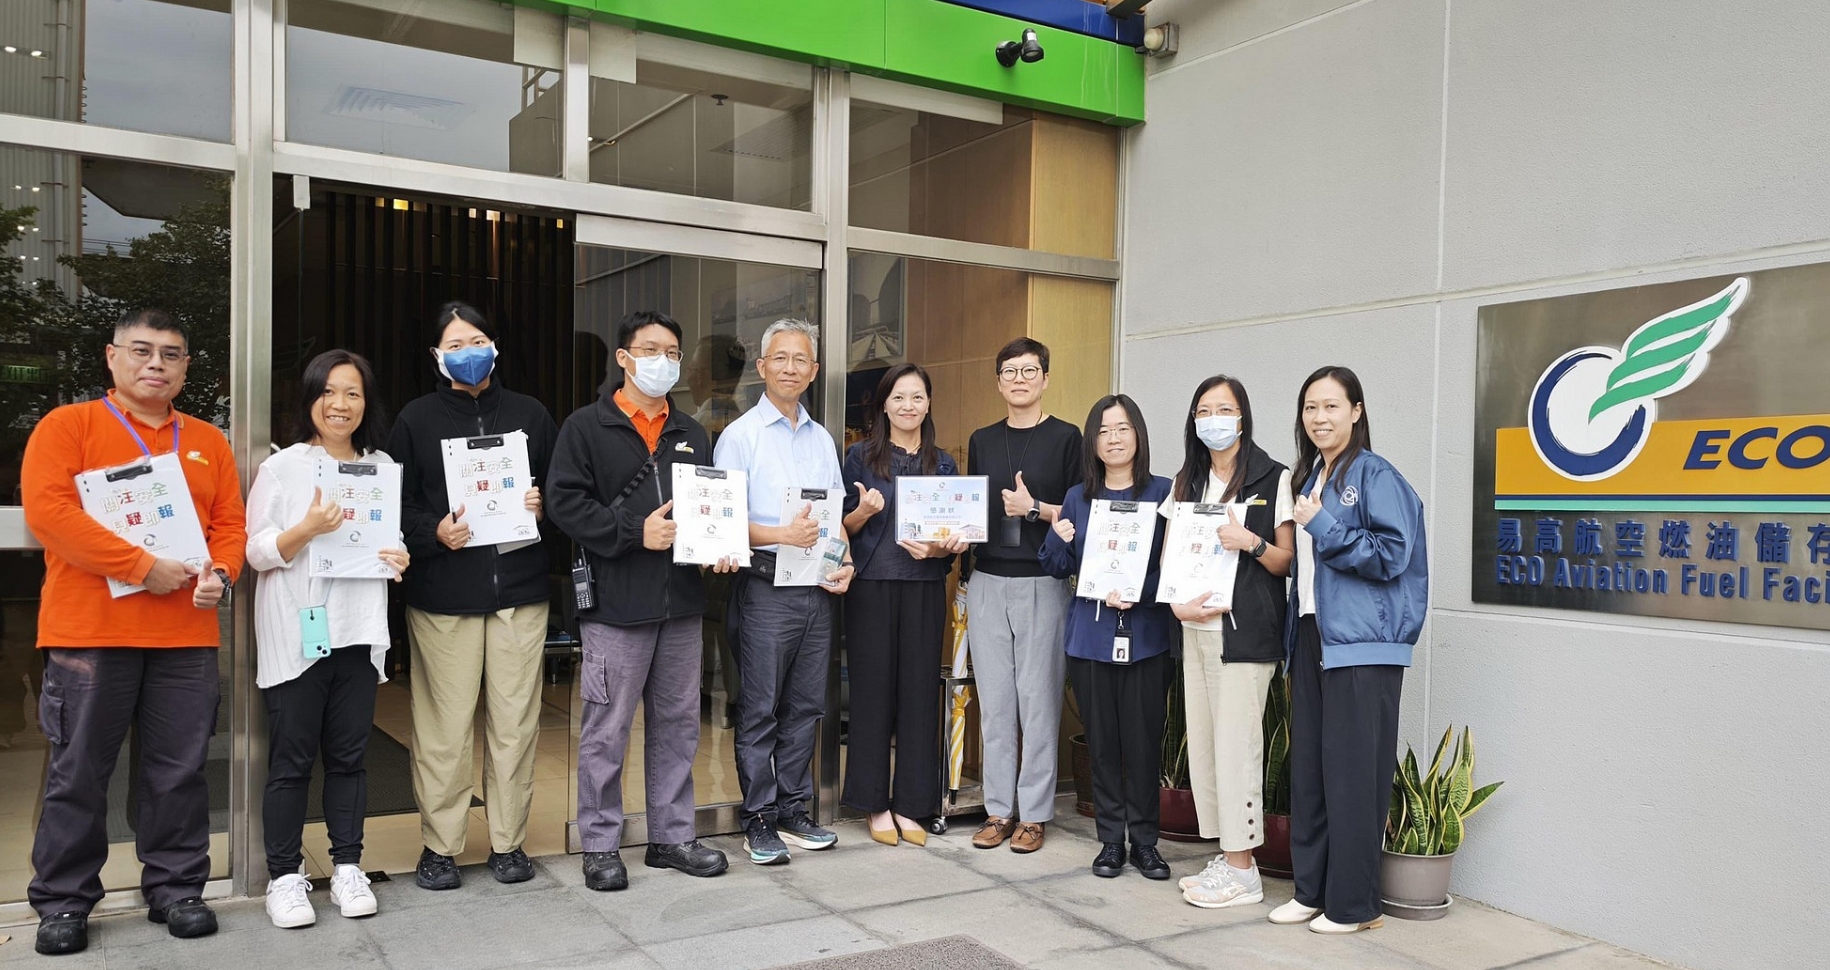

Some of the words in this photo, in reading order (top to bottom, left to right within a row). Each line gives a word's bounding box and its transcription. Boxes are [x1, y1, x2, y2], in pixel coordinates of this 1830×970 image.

[1683, 425, 1830, 470] ECO
[101, 482, 169, 513] 關注安全
[112, 504, 175, 534] 見疑即報
[342, 508, 382, 525] 疑即報
[1497, 517, 1830, 565] 易高航空燃油儲存
[1496, 555, 1545, 586] ECO
[1554, 558, 1668, 595] Aviation
[1681, 563, 1749, 599] Fuel
